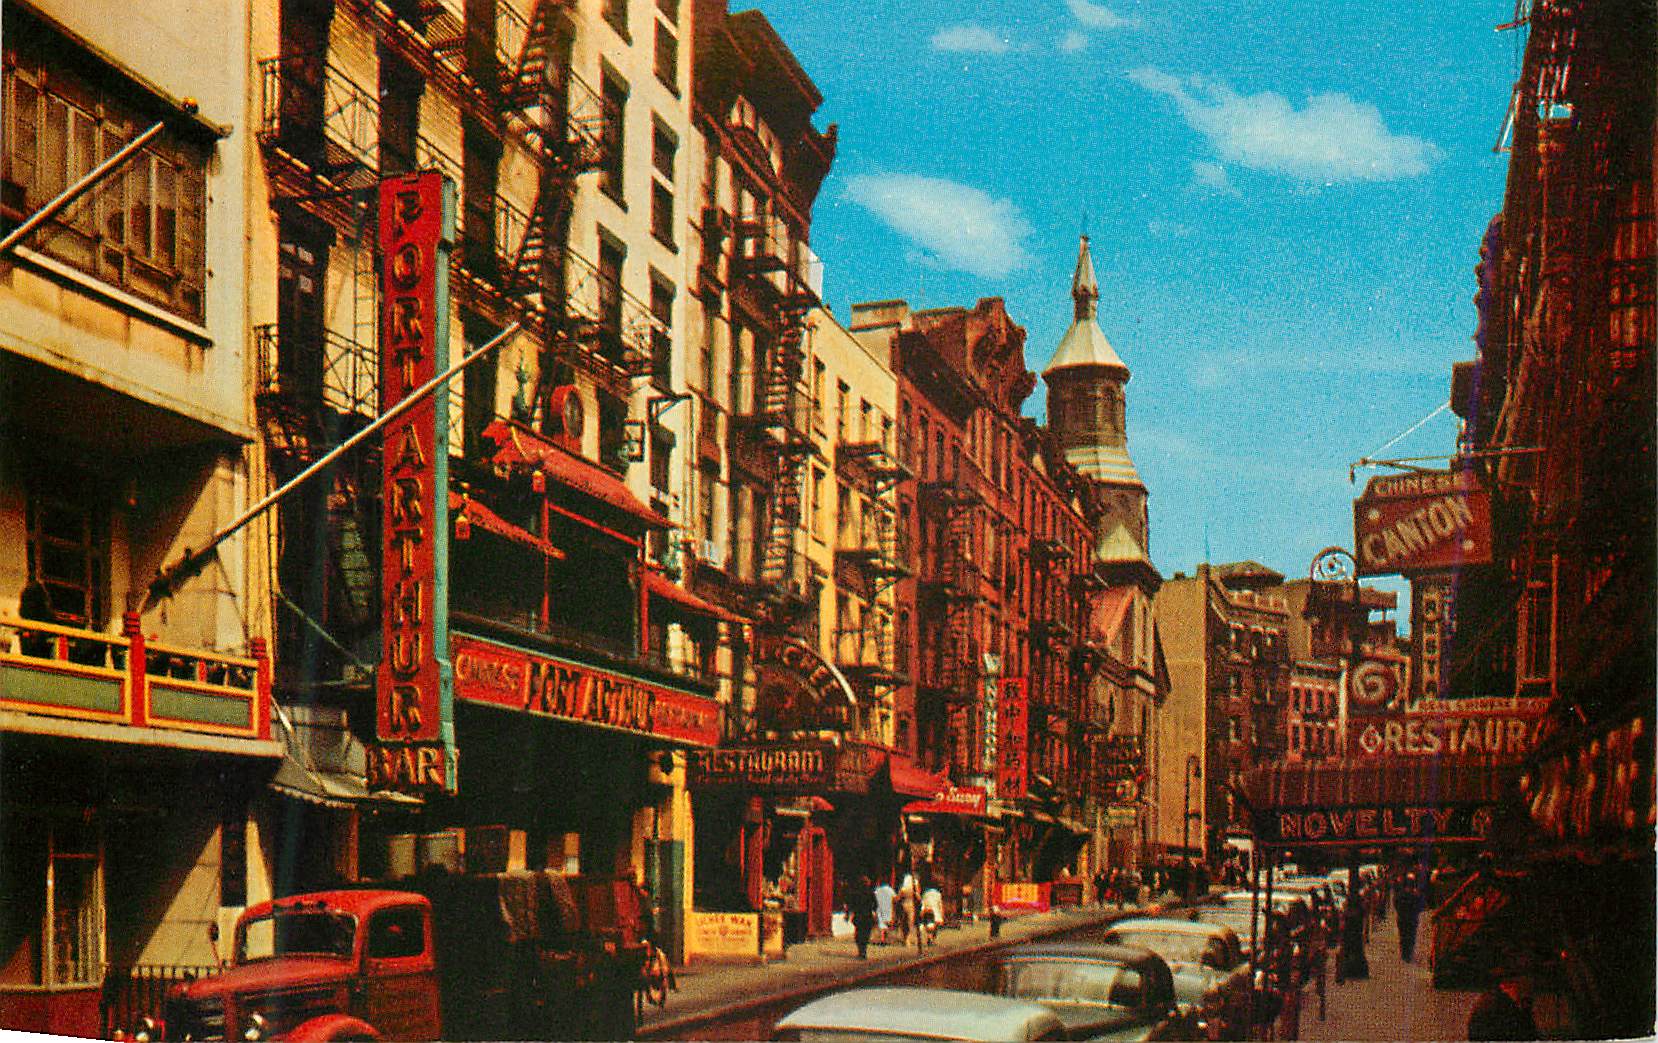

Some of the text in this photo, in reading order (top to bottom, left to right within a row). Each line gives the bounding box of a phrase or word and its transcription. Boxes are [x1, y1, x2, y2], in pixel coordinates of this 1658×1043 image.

[389, 188, 427, 732] PORT ARTHUR
[1362, 496, 1474, 567] CANTON
[1280, 807, 1454, 840] NOVELTY
